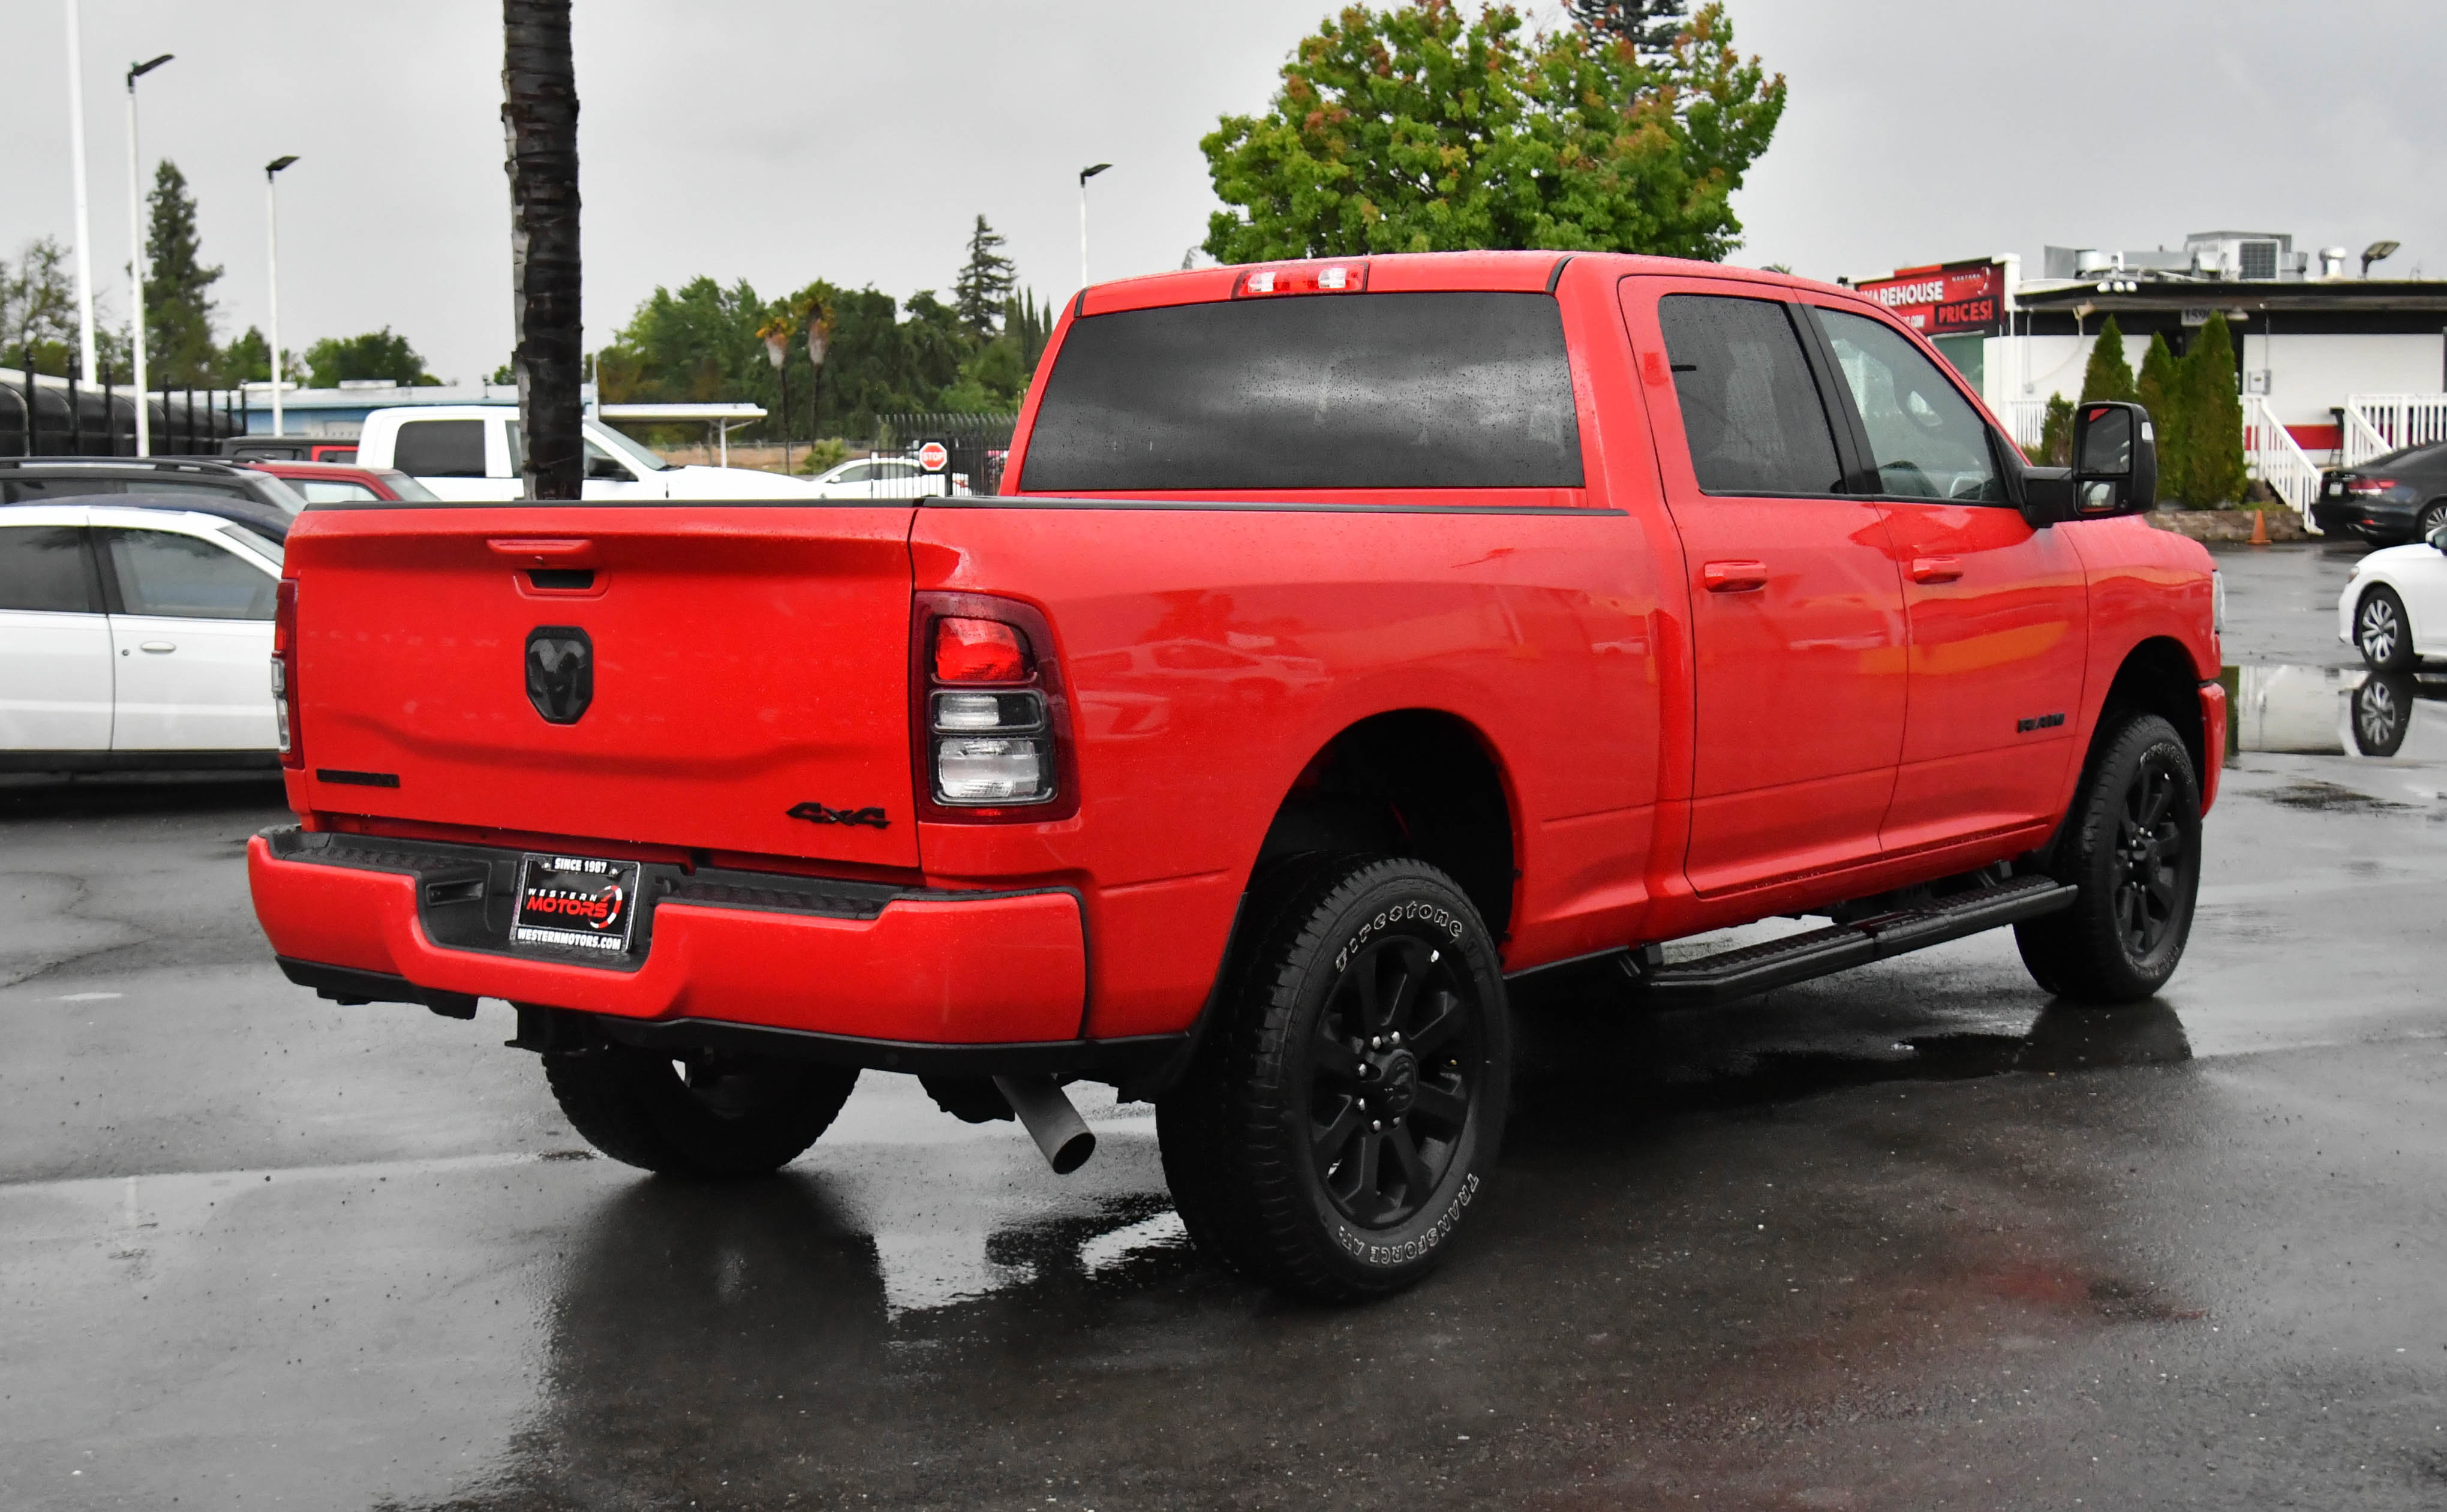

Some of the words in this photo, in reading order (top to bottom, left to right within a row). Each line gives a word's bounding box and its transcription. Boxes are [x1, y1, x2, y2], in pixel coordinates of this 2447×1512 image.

[1938, 300, 1992, 323] PRICES!
[922, 451, 944, 462] STOP
[554, 858, 582, 871] SINCE
[584, 860, 607, 873] 1987
[528, 888, 597, 902] WESTERN
[526, 896, 608, 918] MOTORS
[518, 927, 621, 950] WESTERNMOTORS.COM
[1370, 1173, 1479, 1264] TRANSFORCE
